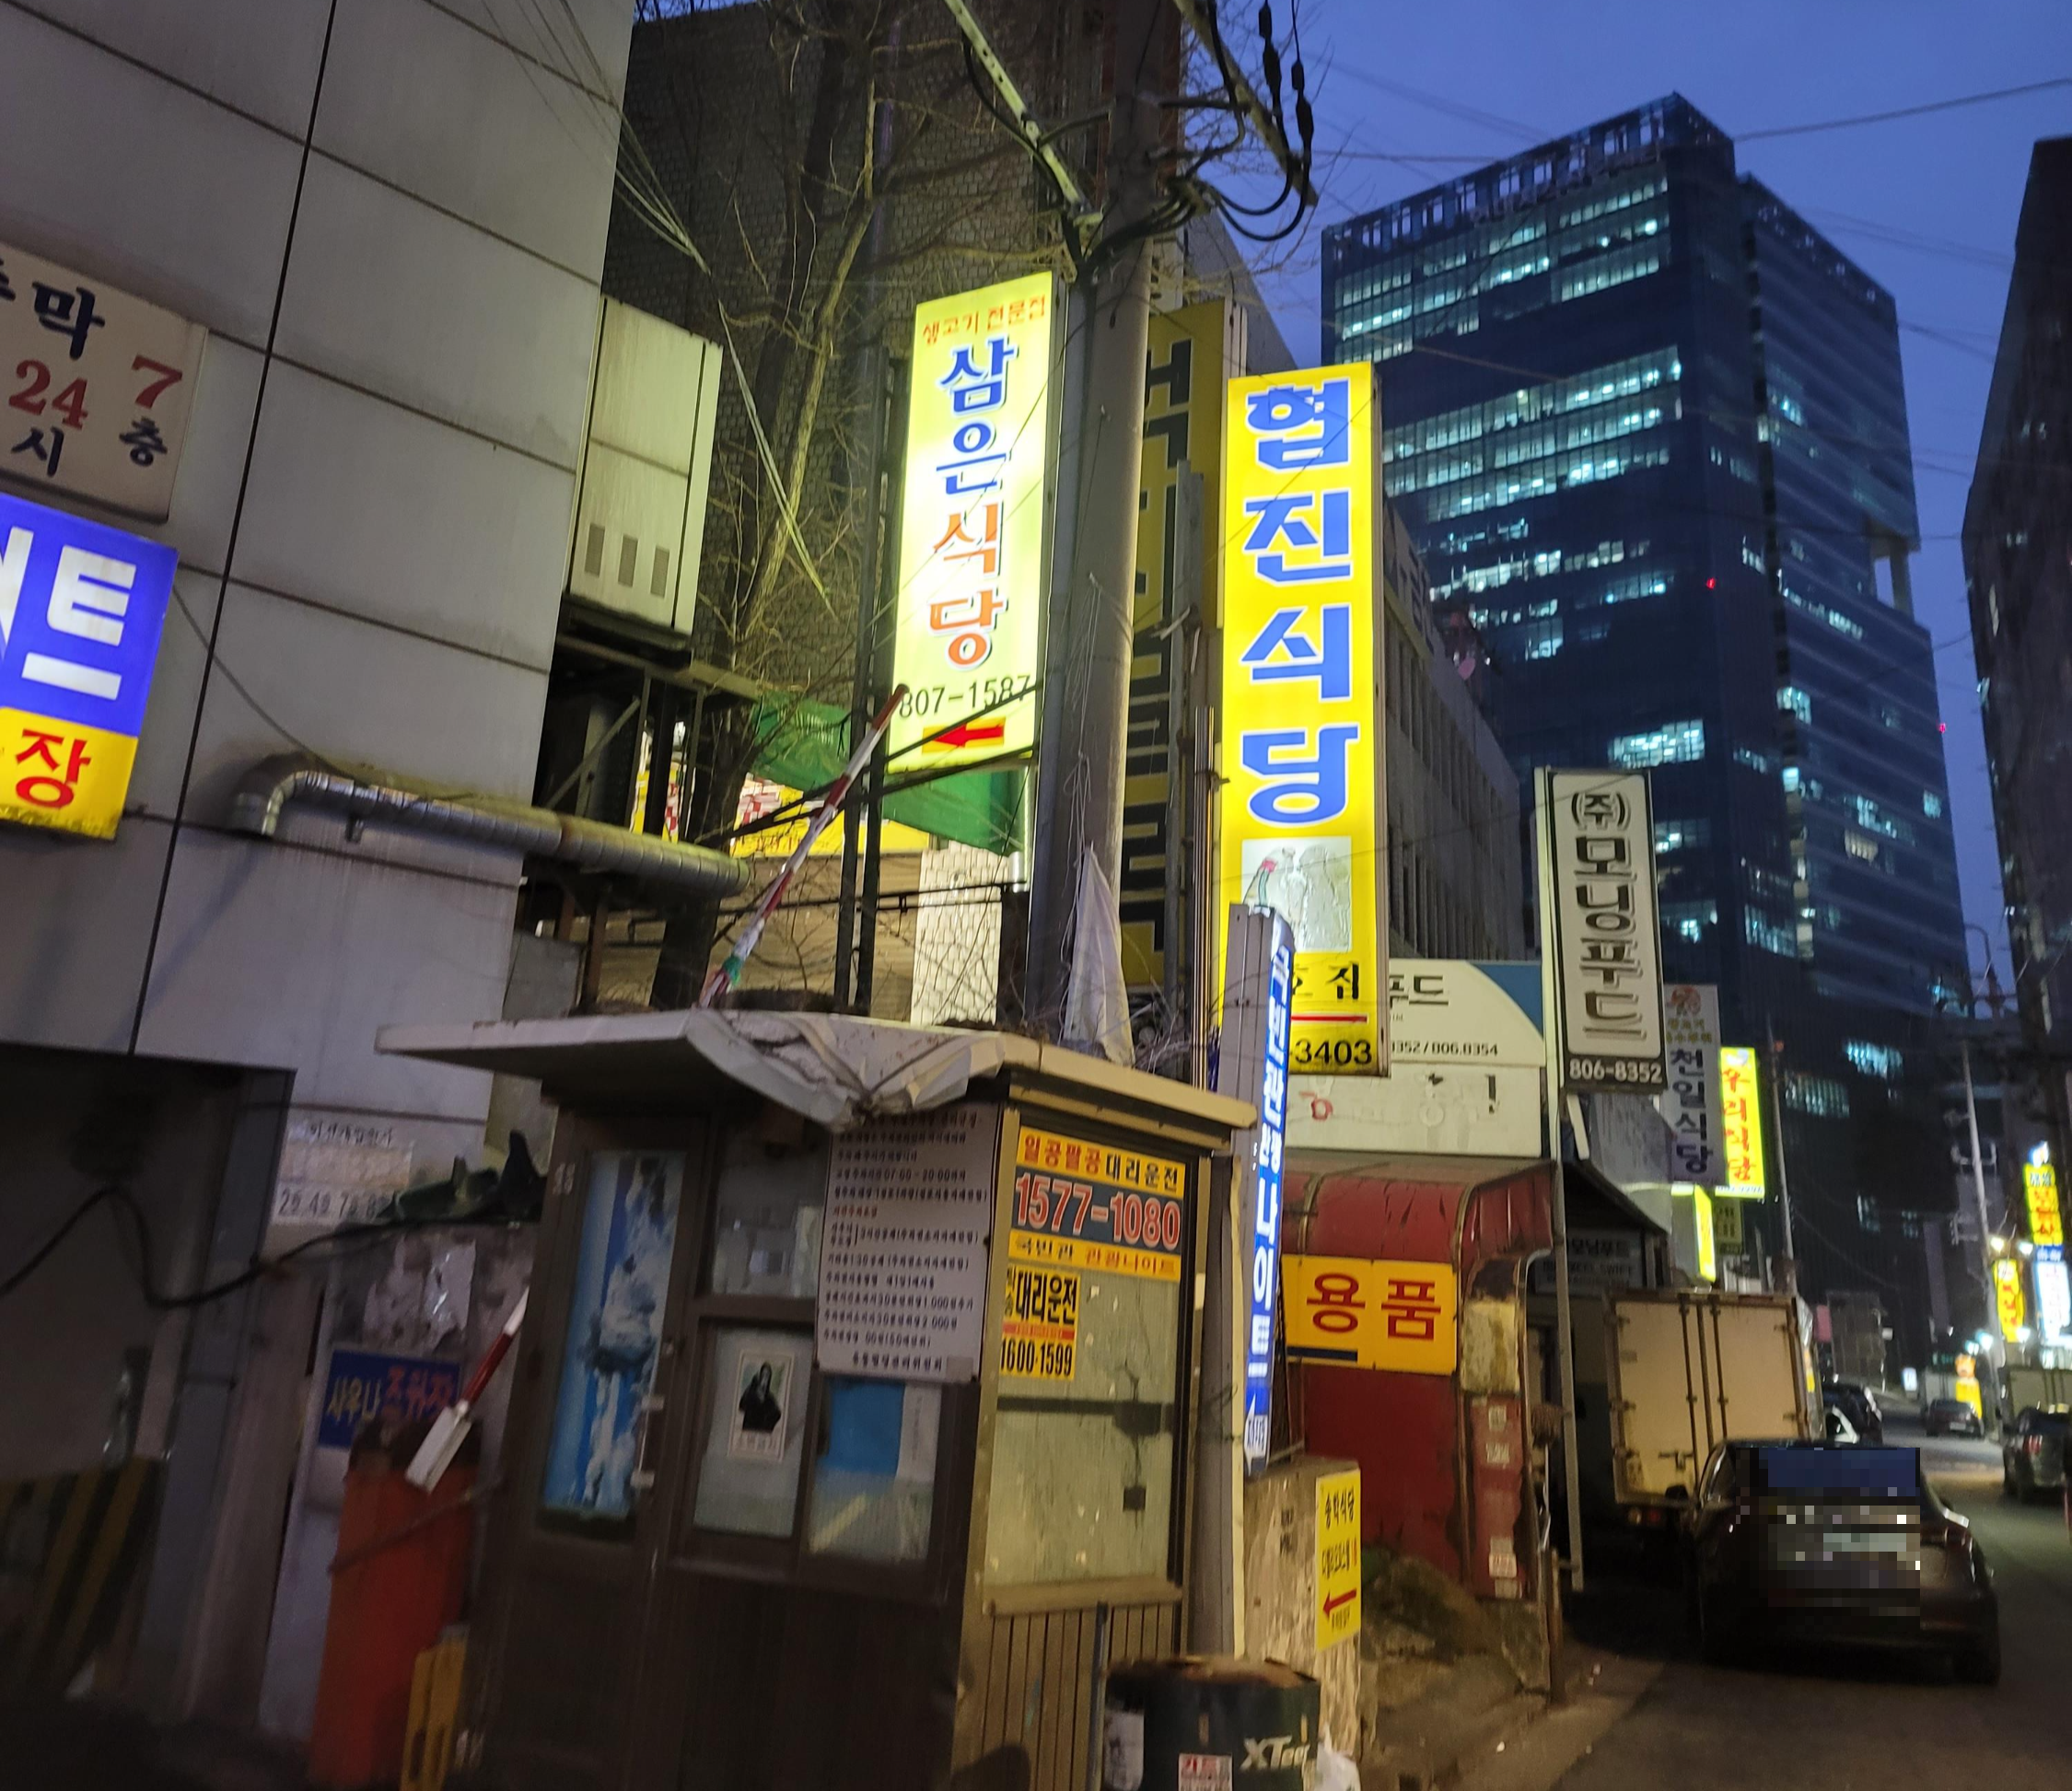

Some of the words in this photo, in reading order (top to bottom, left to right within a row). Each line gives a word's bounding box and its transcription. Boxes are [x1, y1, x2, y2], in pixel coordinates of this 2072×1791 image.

[9, 358, 88, 430] 24
[131, 355, 182, 409] 7
[12, 426, 64, 476] 시
[120, 416, 168, 466] 층
[927, 335, 1017, 669] 삼은식당
[1240, 378, 1359, 824] 협진식당
[898, 675, 1031, 718] 807-1587
[15, 728, 91, 809] 장
[1289, 1038, 1373, 1065] 3403
[1569, 1059, 1663, 1084] 806-8352
[1670, 1048, 1713, 1174] 천일식당
[1024, 1134, 1101, 1176] 일공팔공
[1105, 1153, 1179, 1193] 대리운전
[1015, 1171, 1182, 1251] 1577-1080
[1015, 1270, 1078, 1326] 대리운전
[1306, 1271, 1442, 1342] 용품
